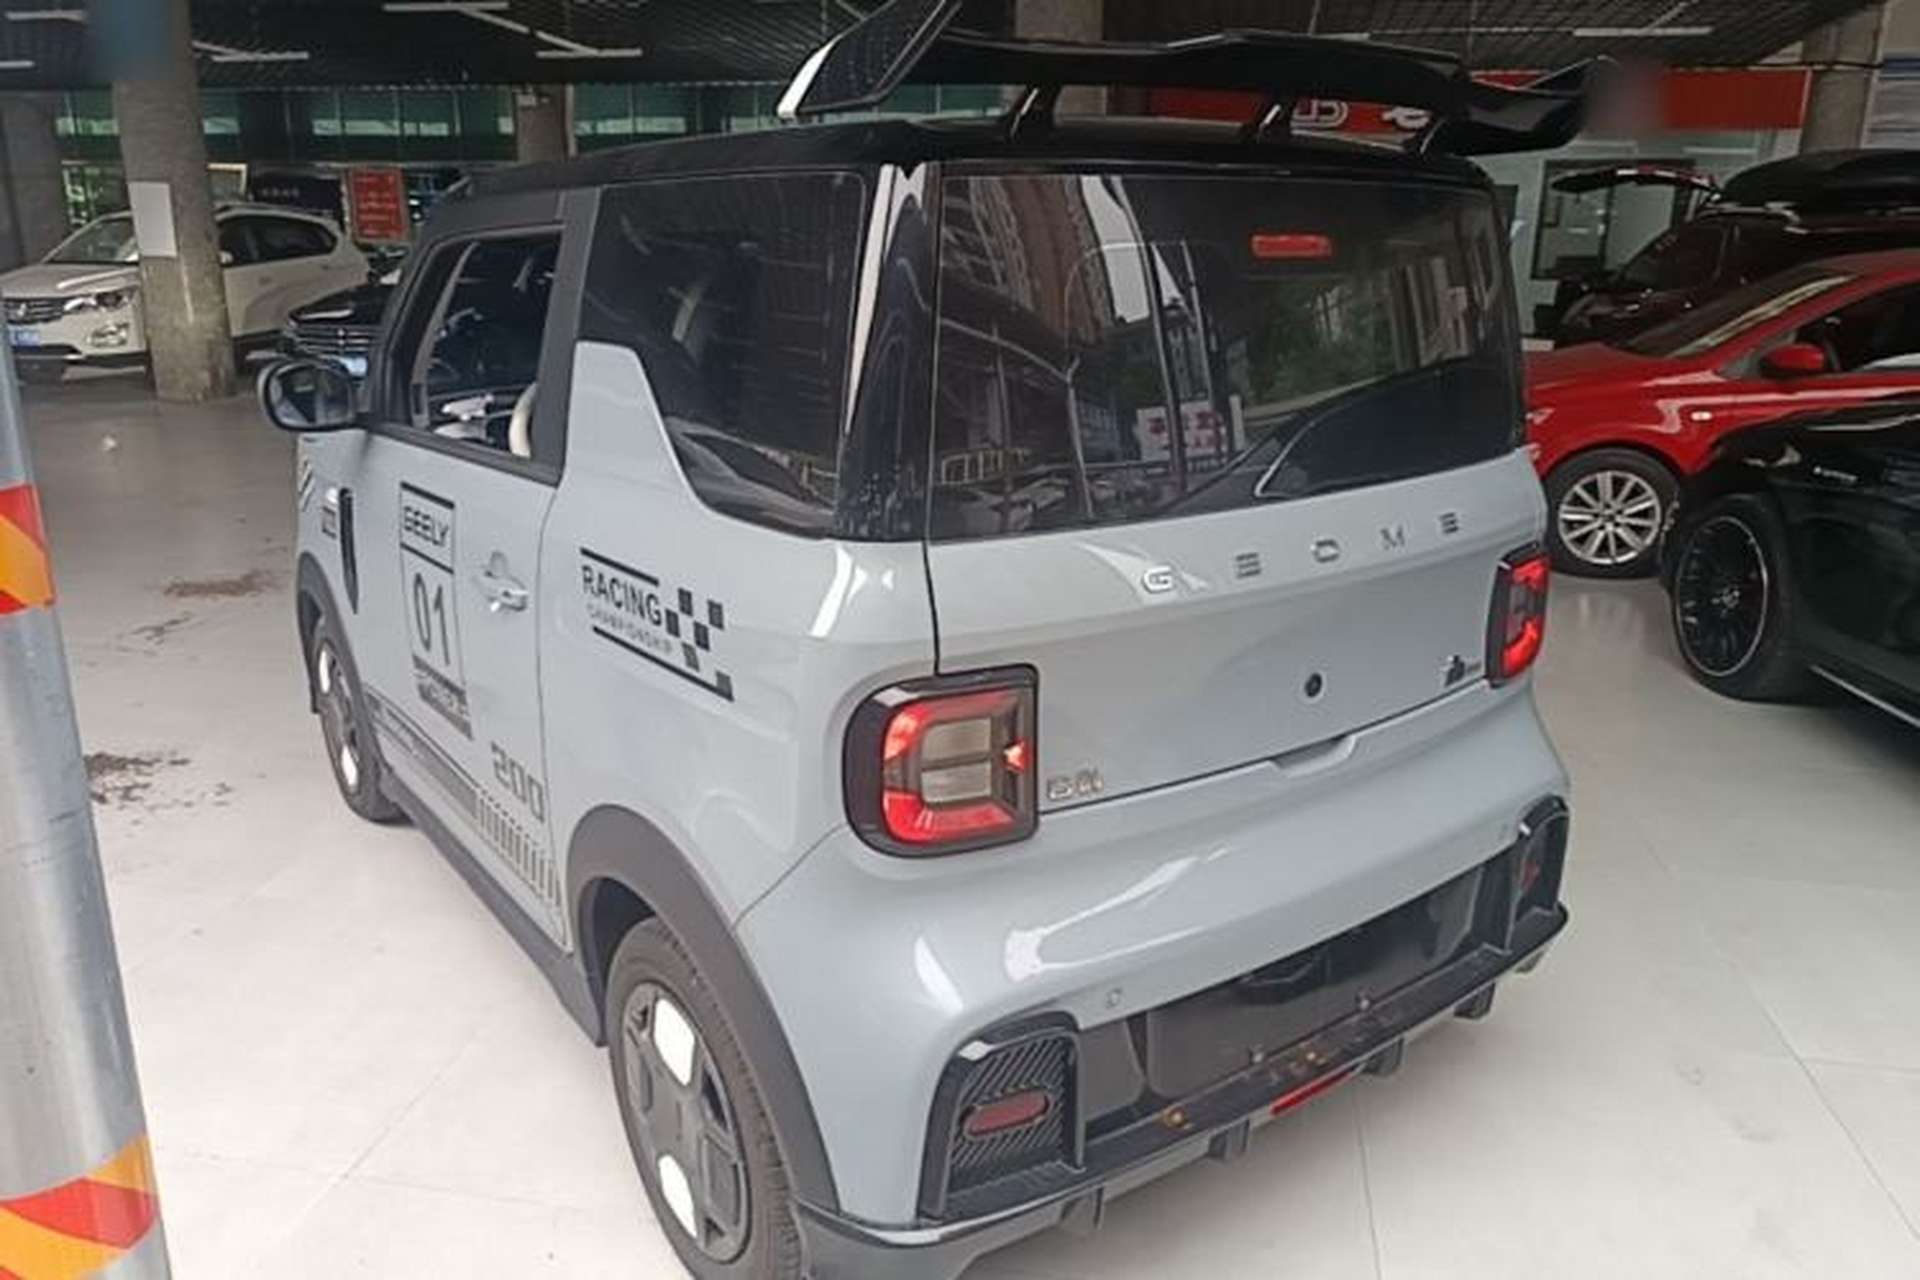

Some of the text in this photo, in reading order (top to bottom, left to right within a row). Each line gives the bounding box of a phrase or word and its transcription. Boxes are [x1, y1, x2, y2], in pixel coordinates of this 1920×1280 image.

[404, 505, 450, 547] GEELY
[1142, 512, 1459, 593] GEOME
[413, 572, 451, 666] 01
[581, 564, 663, 627] RACING
[491, 741, 545, 823] 200
